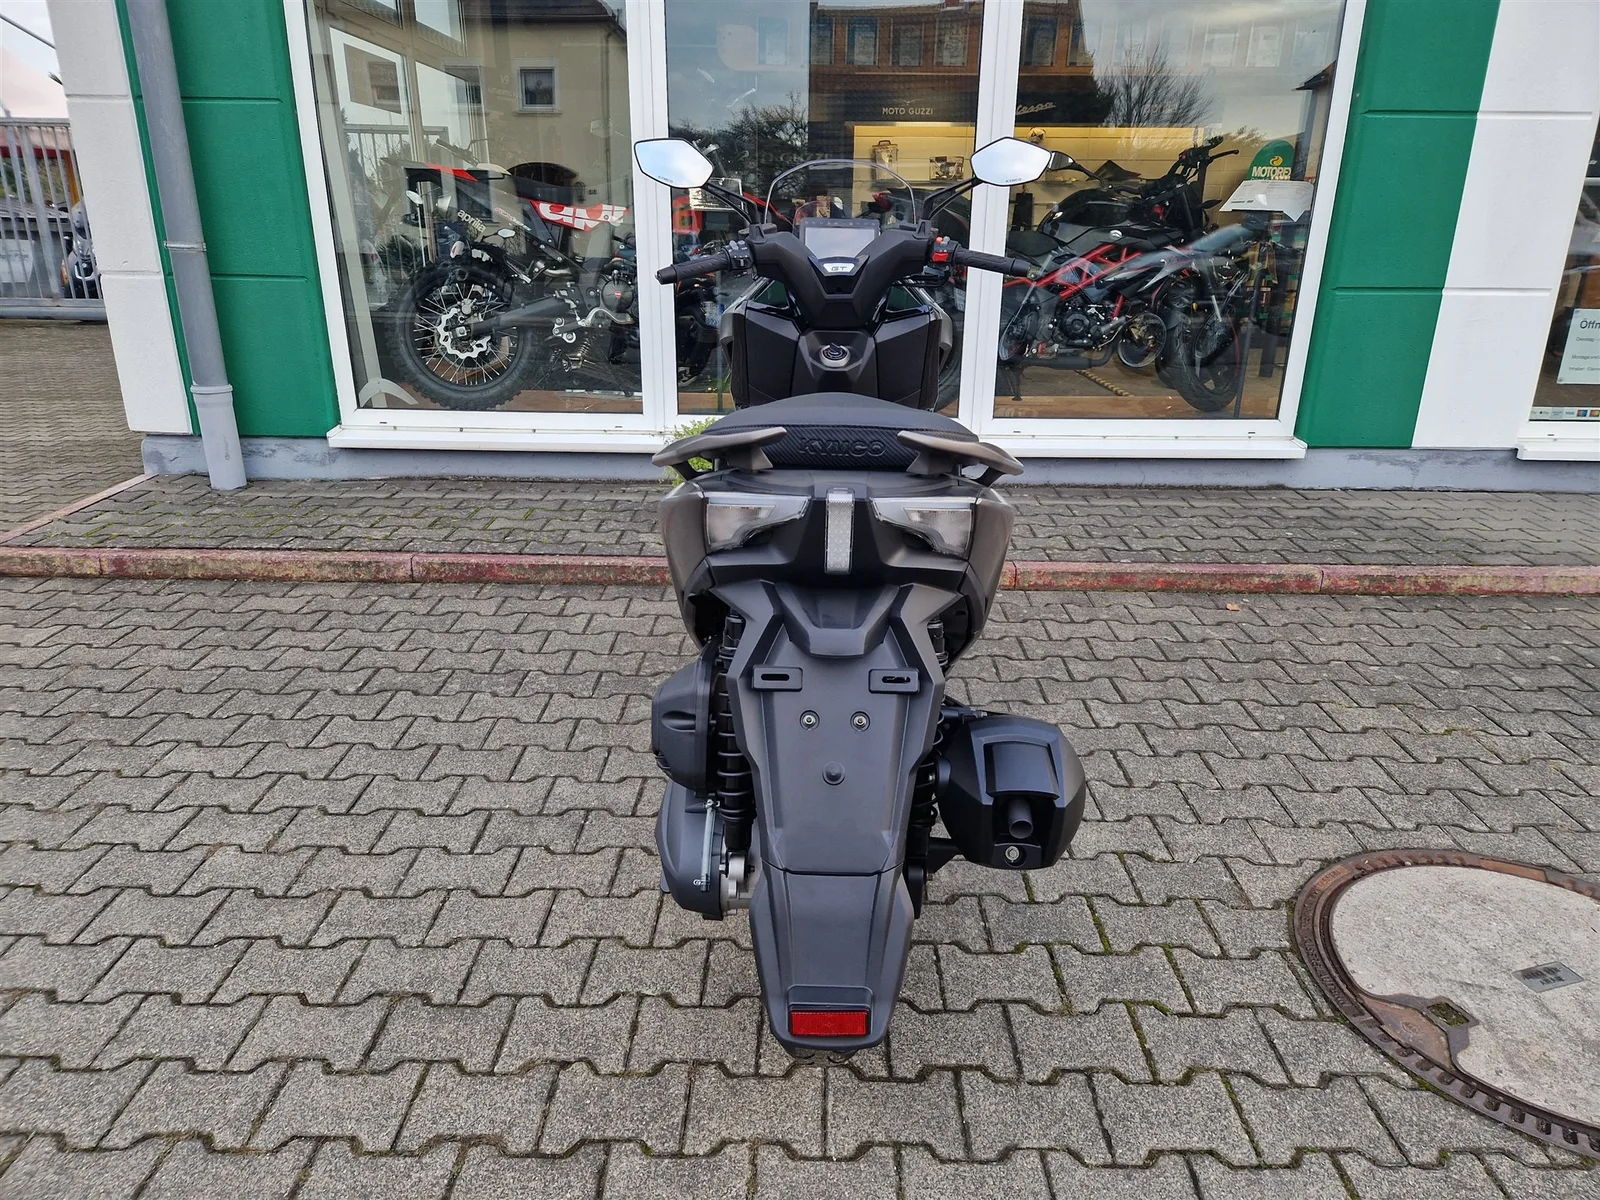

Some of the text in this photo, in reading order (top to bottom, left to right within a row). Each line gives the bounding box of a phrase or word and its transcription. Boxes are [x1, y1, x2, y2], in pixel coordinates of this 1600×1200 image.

[882, 107, 934, 115] MOTO GUZZI
[457, 209, 487, 233] aprilia
